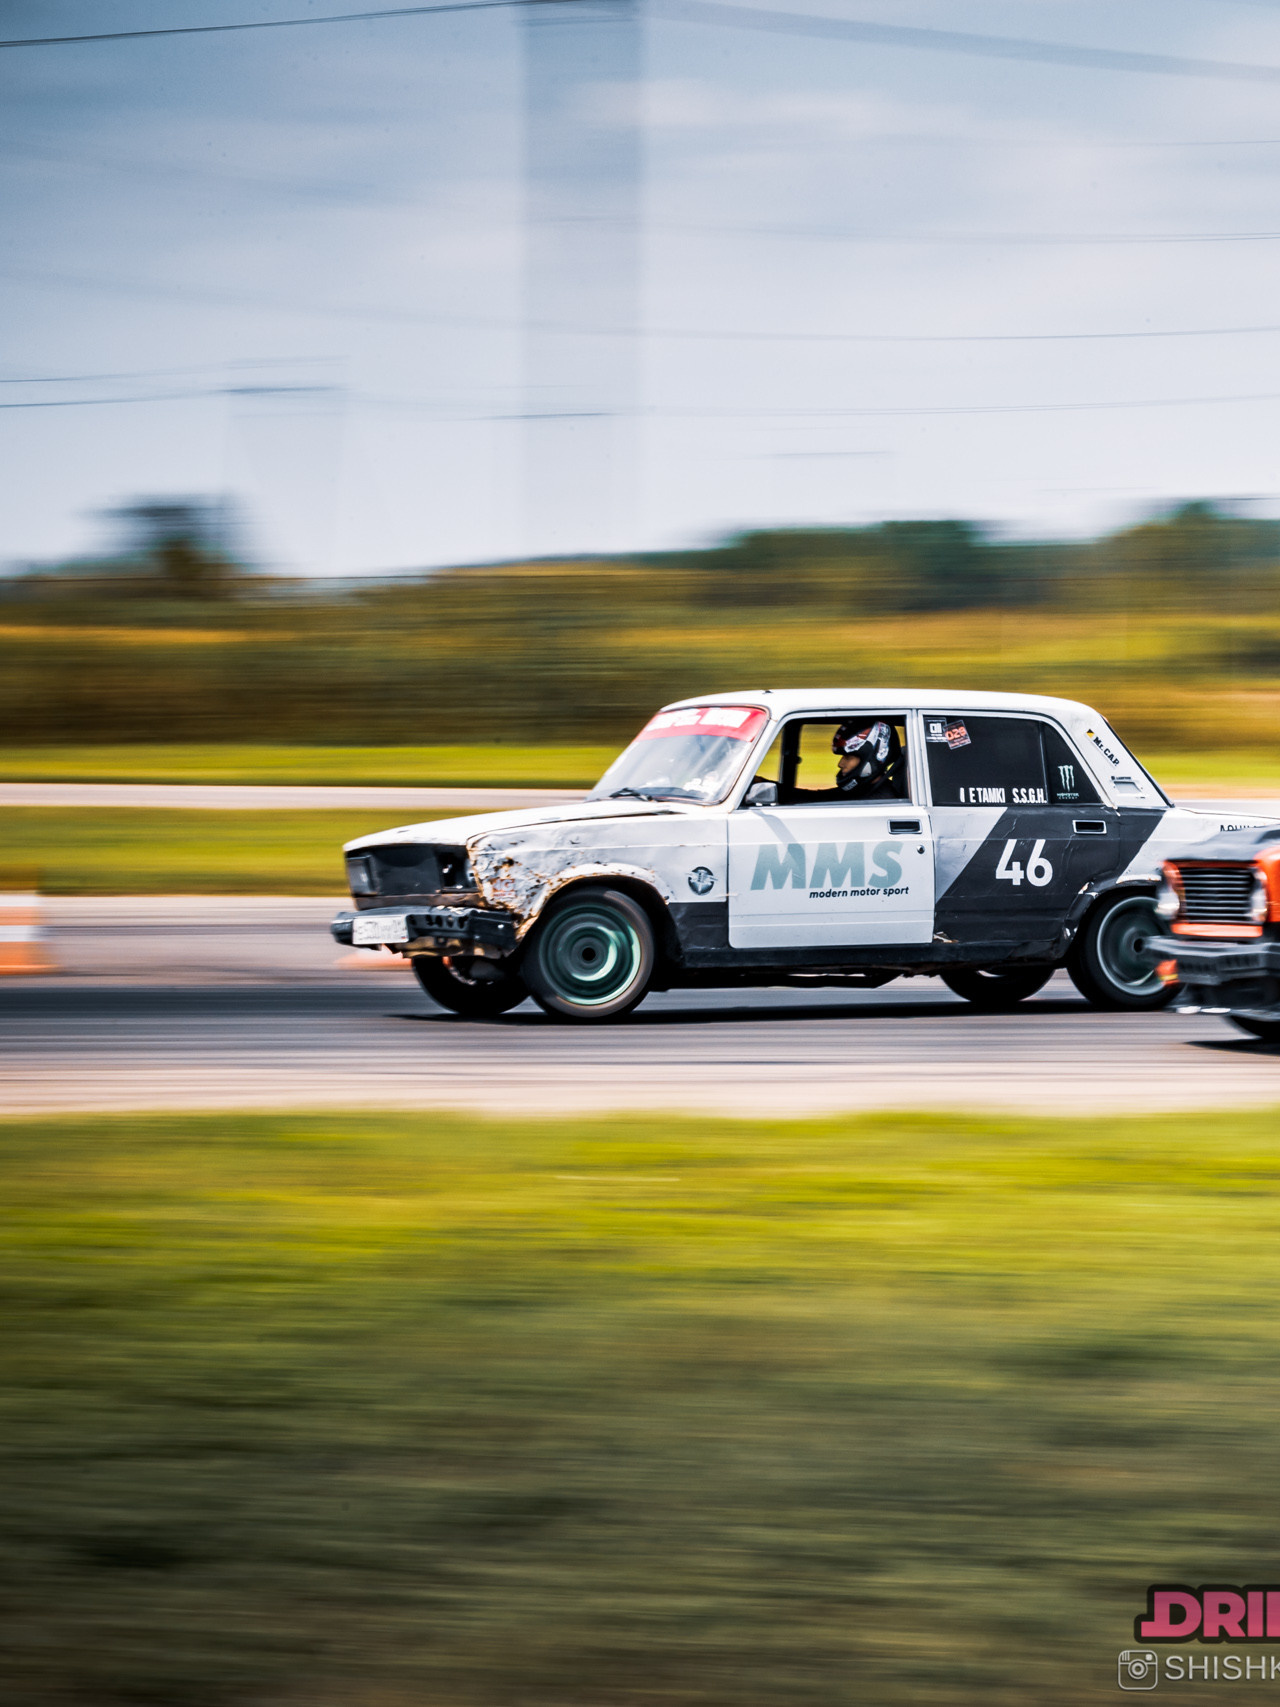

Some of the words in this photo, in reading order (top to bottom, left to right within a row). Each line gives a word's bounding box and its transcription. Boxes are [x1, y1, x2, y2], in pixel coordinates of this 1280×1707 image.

[1093, 736, 1104, 751] Mr.
[750, 840, 904, 891] MMS
[995, 838, 1053, 887] 46
[809, 888, 848, 899] modern
[850, 887, 881, 897] motor
[883, 886, 909, 898] sport
